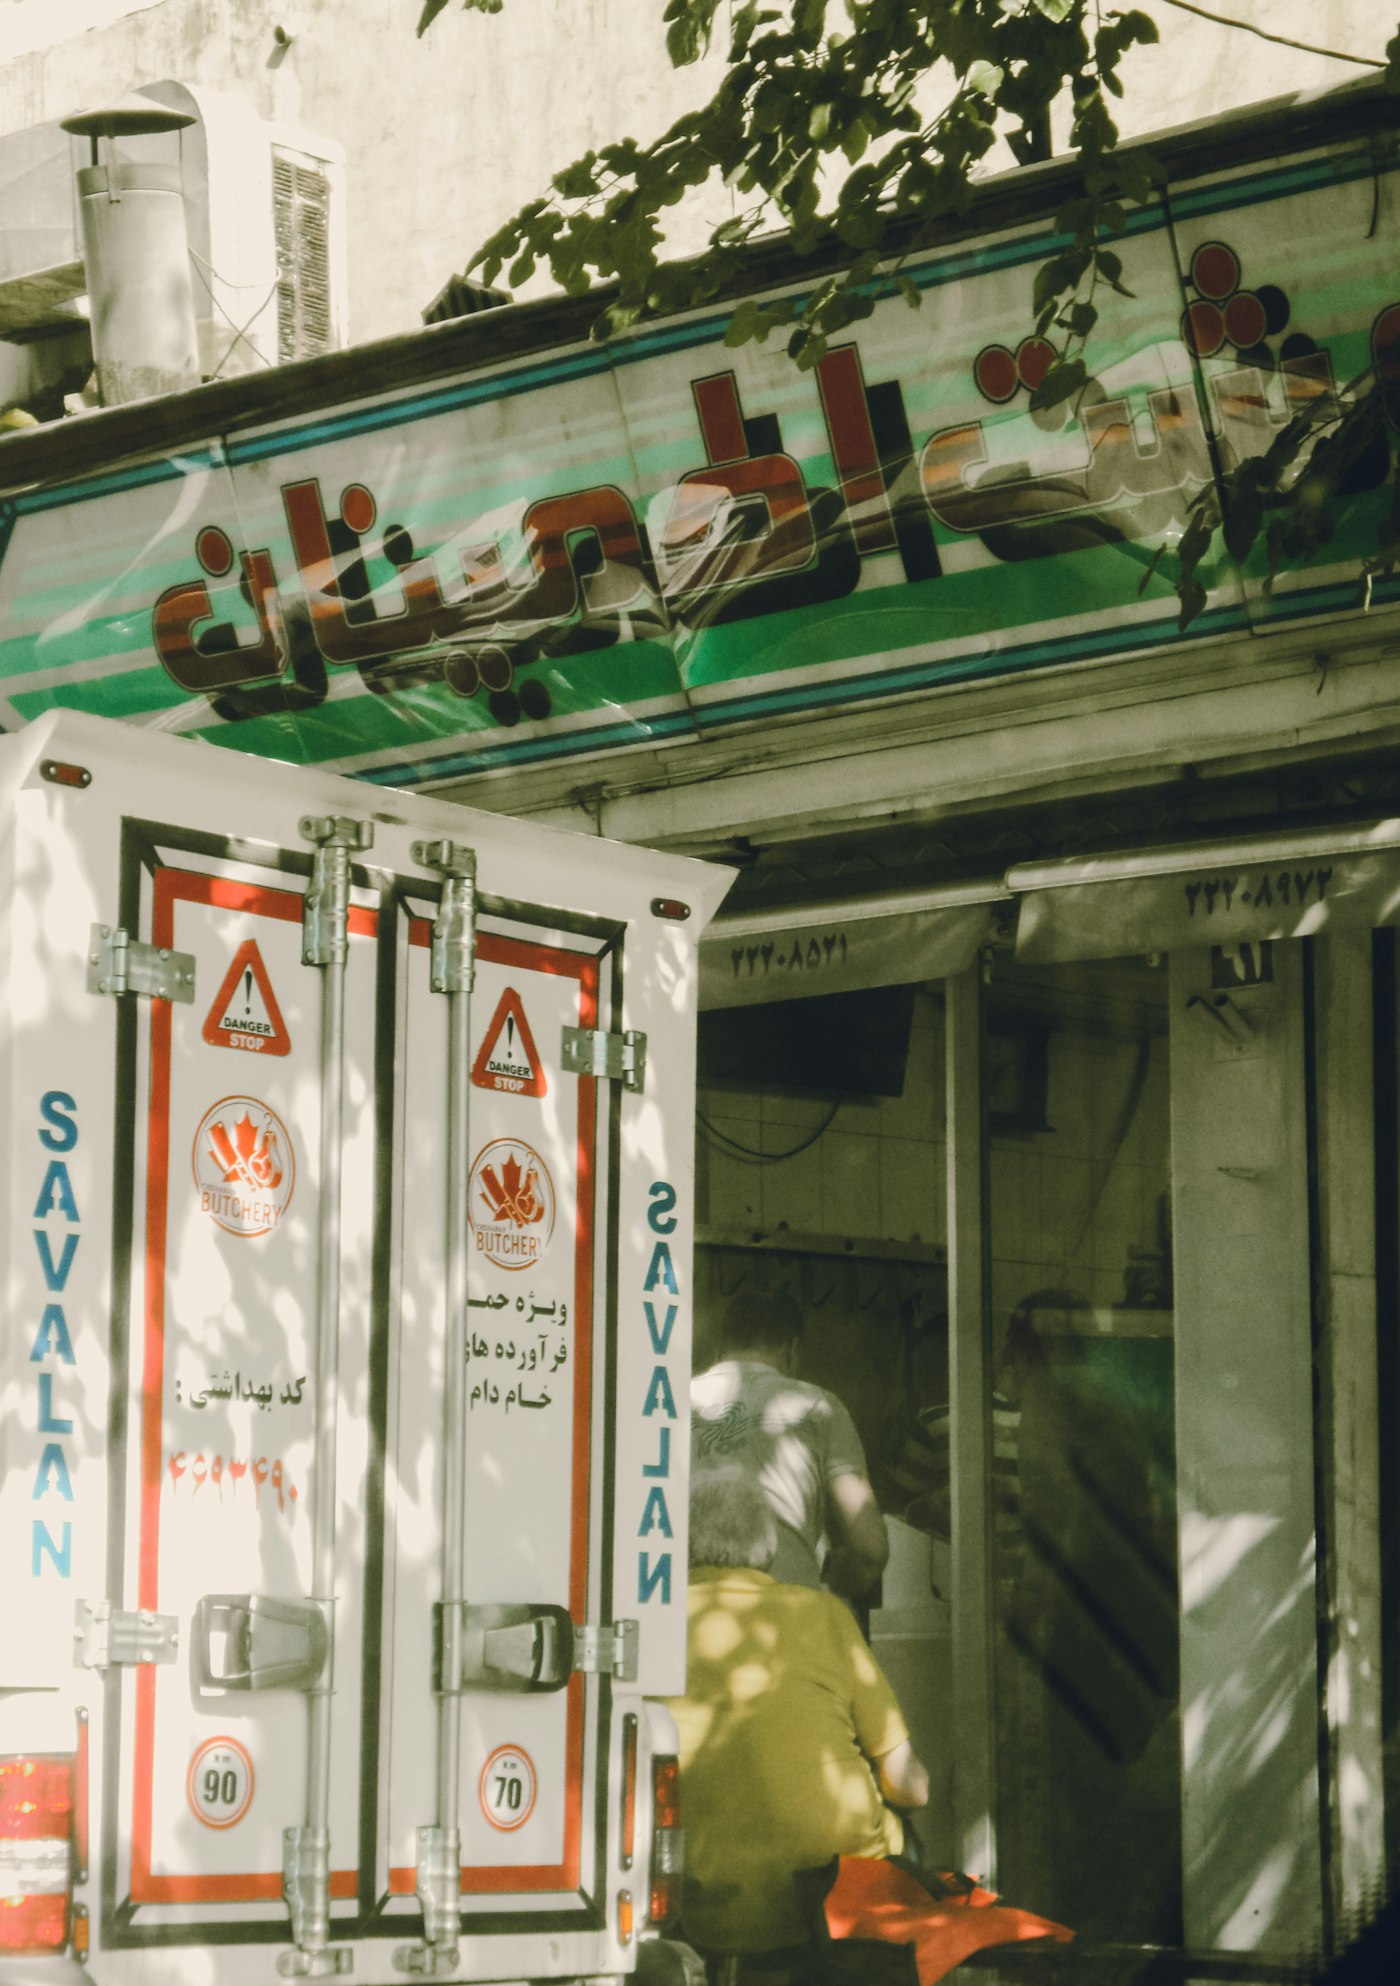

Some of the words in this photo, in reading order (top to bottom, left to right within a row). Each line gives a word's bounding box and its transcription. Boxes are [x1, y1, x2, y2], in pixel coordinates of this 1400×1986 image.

[152, 341, 898, 698] اطمینان
[224, 1017, 271, 1034] DANGER
[230, 1033, 265, 1050] STOP
[489, 1061, 530, 1077] DANGER
[495, 1076, 525, 1092] STOP
[201, 1191, 282, 1227] BUTCHERY
[515, 1290, 567, 1326] ویژه
[29, 1090, 81, 1579] SAVALAN
[280, 1376, 306, 1405] کد
[470, 1378, 499, 1411] دام
[505, 1384, 552, 1415] خام
[203, 1769, 237, 1805] 90
[495, 1776, 522, 1810] 70
